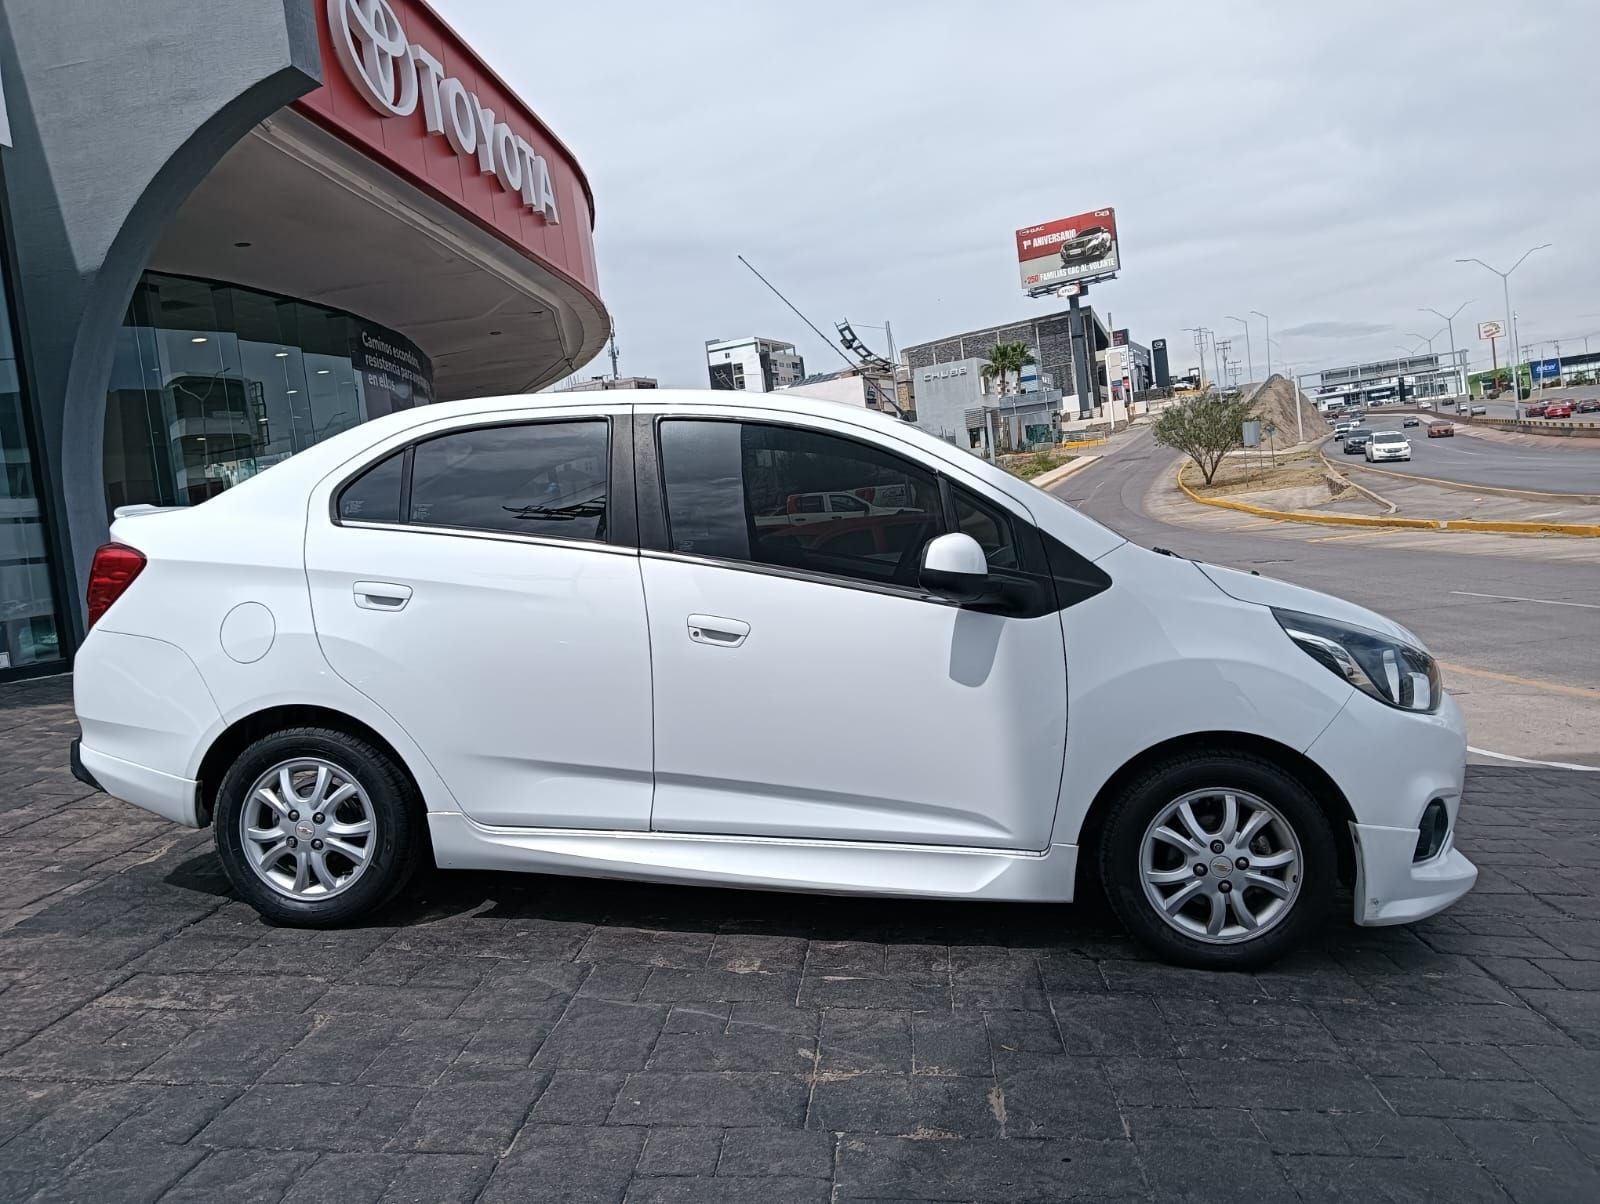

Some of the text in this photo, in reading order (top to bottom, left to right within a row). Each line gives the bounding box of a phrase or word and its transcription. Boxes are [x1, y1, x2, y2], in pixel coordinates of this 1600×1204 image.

[409, 44, 560, 225] TOYOTA
[1033, 229, 1077, 248] ANIVERSARIO
[1039, 267, 1067, 281] FAMILIAS
[1080, 264, 1088, 272] AL
[1089, 258, 1115, 271] VOLANTE
[368, 373, 378, 387] en
